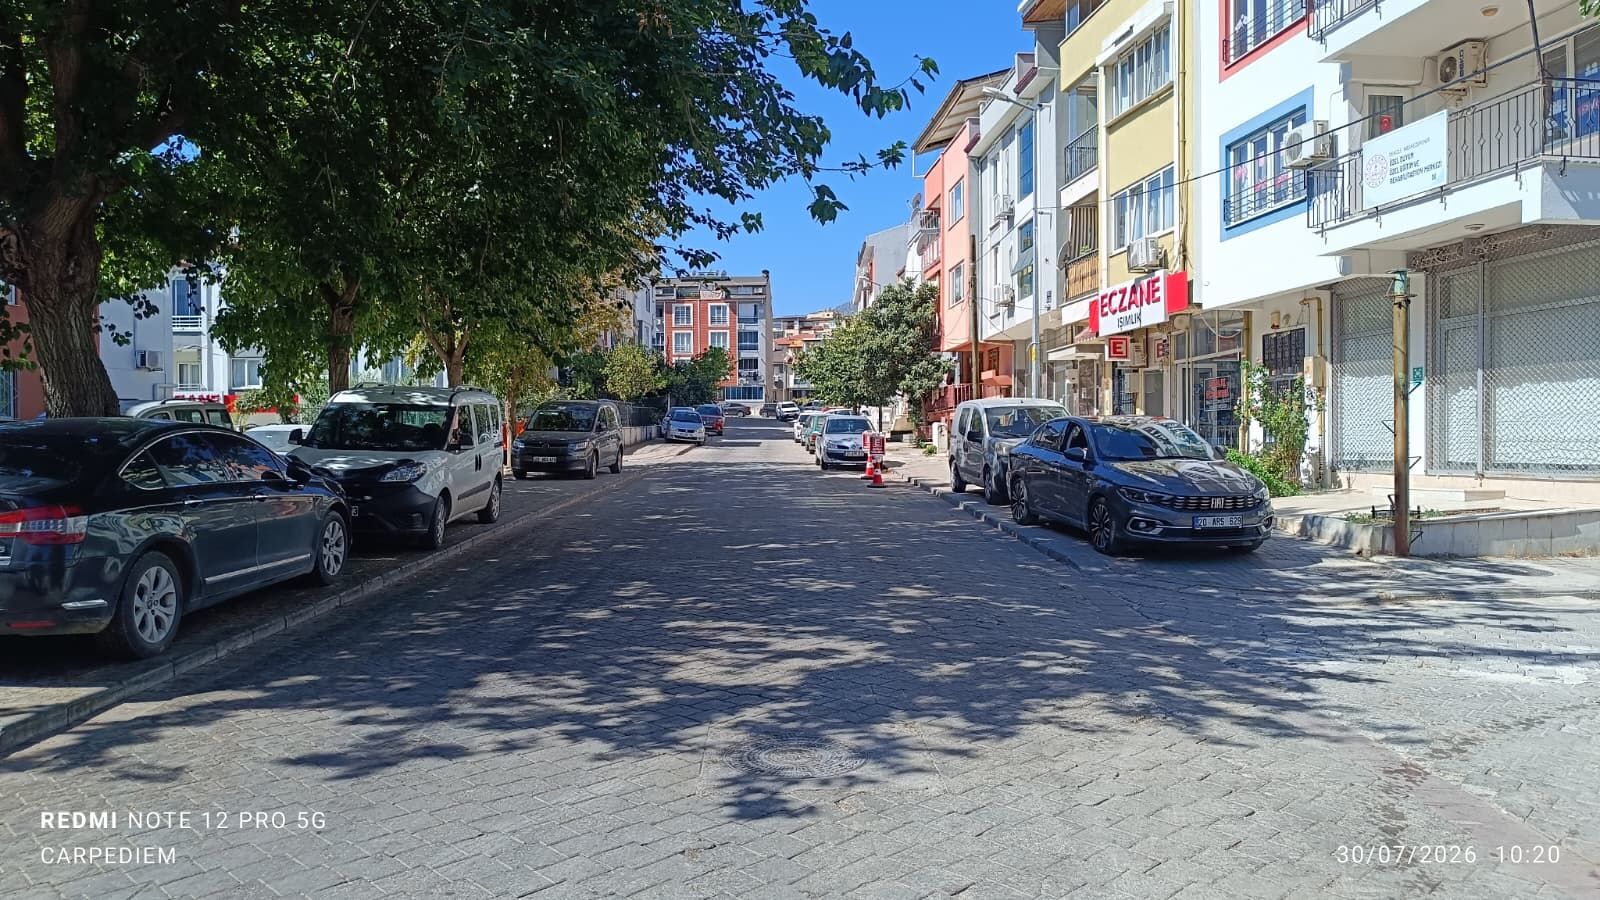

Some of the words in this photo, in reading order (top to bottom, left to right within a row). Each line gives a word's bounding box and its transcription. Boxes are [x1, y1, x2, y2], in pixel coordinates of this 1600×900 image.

[1100, 275, 1160, 317] ECZANE
[1211, 497, 1224, 508] FIAT
[1199, 518, 1207, 526] 20
